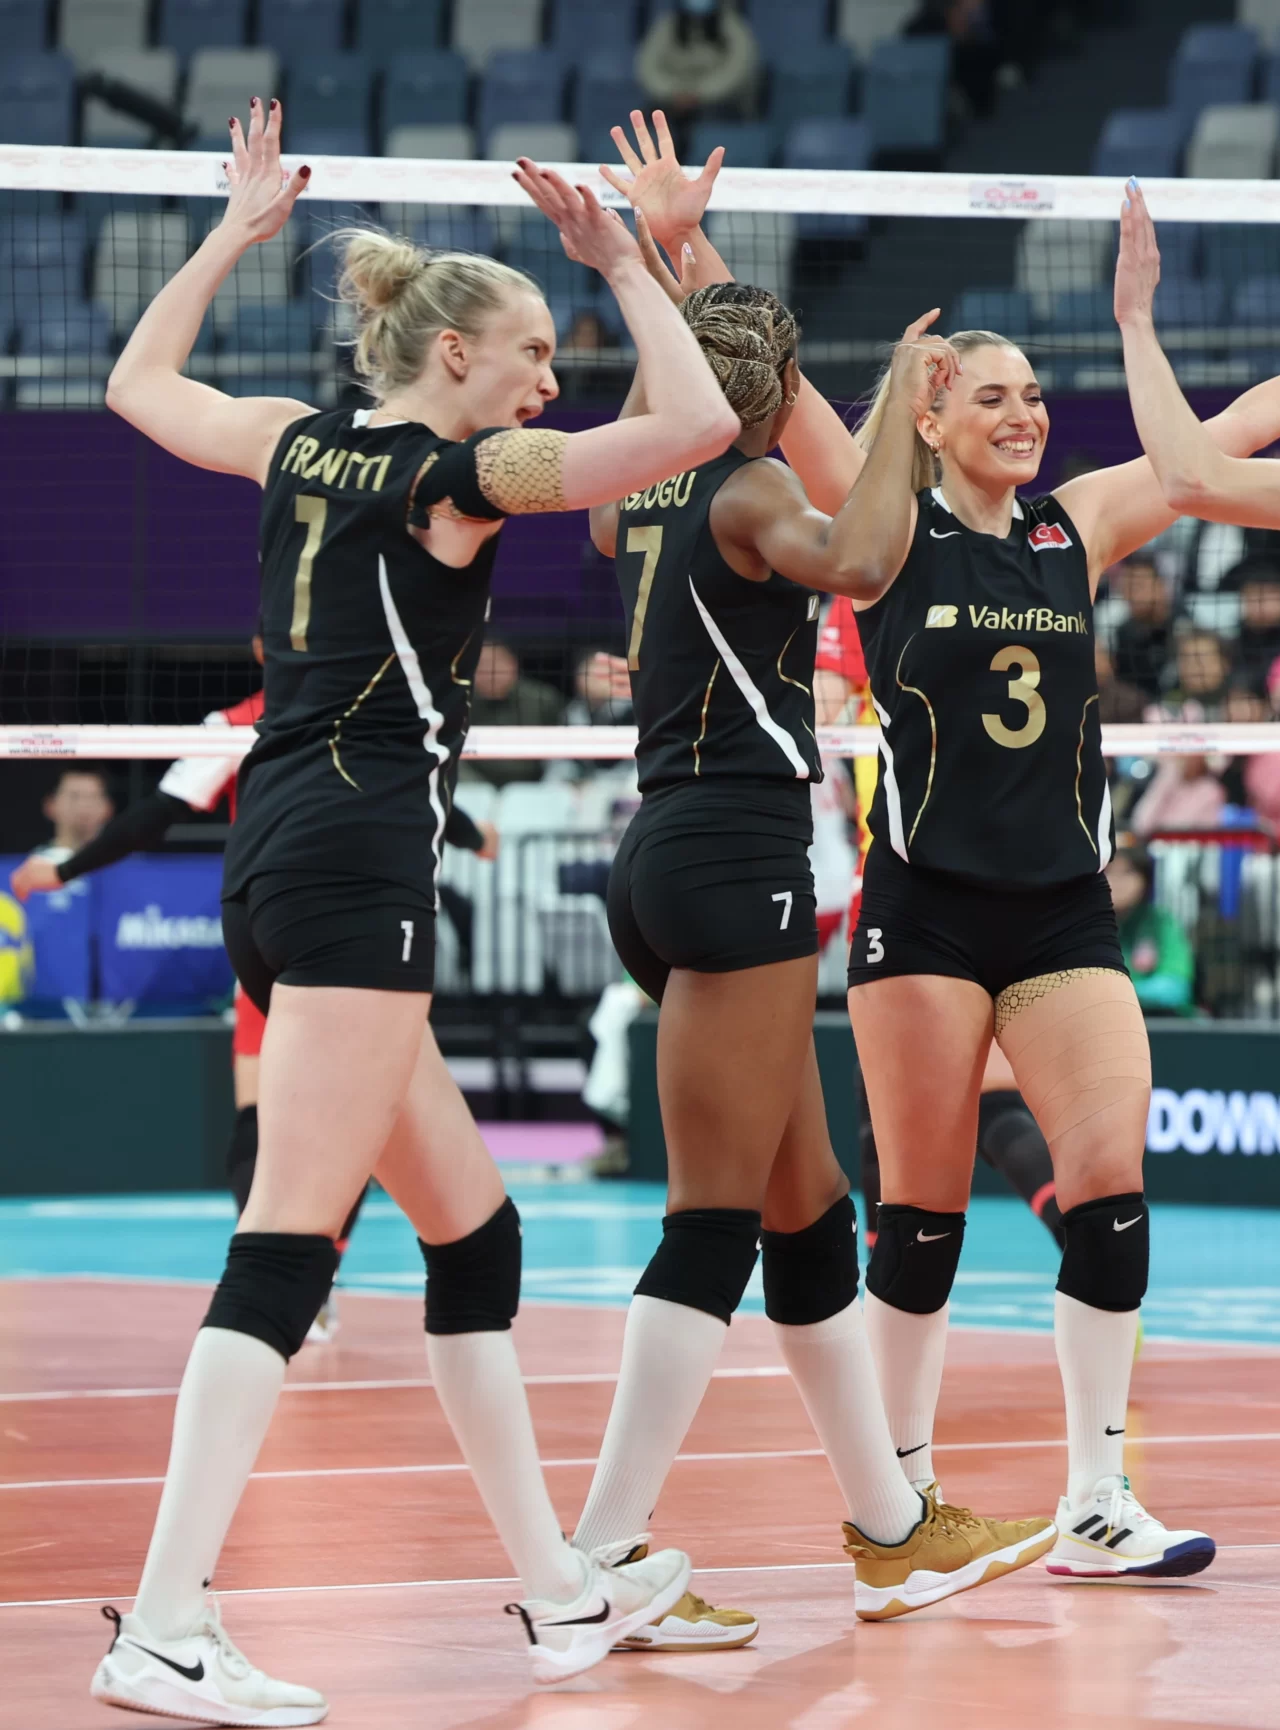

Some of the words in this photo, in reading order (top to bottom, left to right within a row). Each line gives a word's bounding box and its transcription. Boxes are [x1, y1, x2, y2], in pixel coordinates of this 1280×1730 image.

[626, 525, 664, 671] 7
[981, 645, 1047, 749] 3
[771, 891, 793, 930] 7
[400, 920, 415, 962] 1
[866, 928, 885, 964] 3
